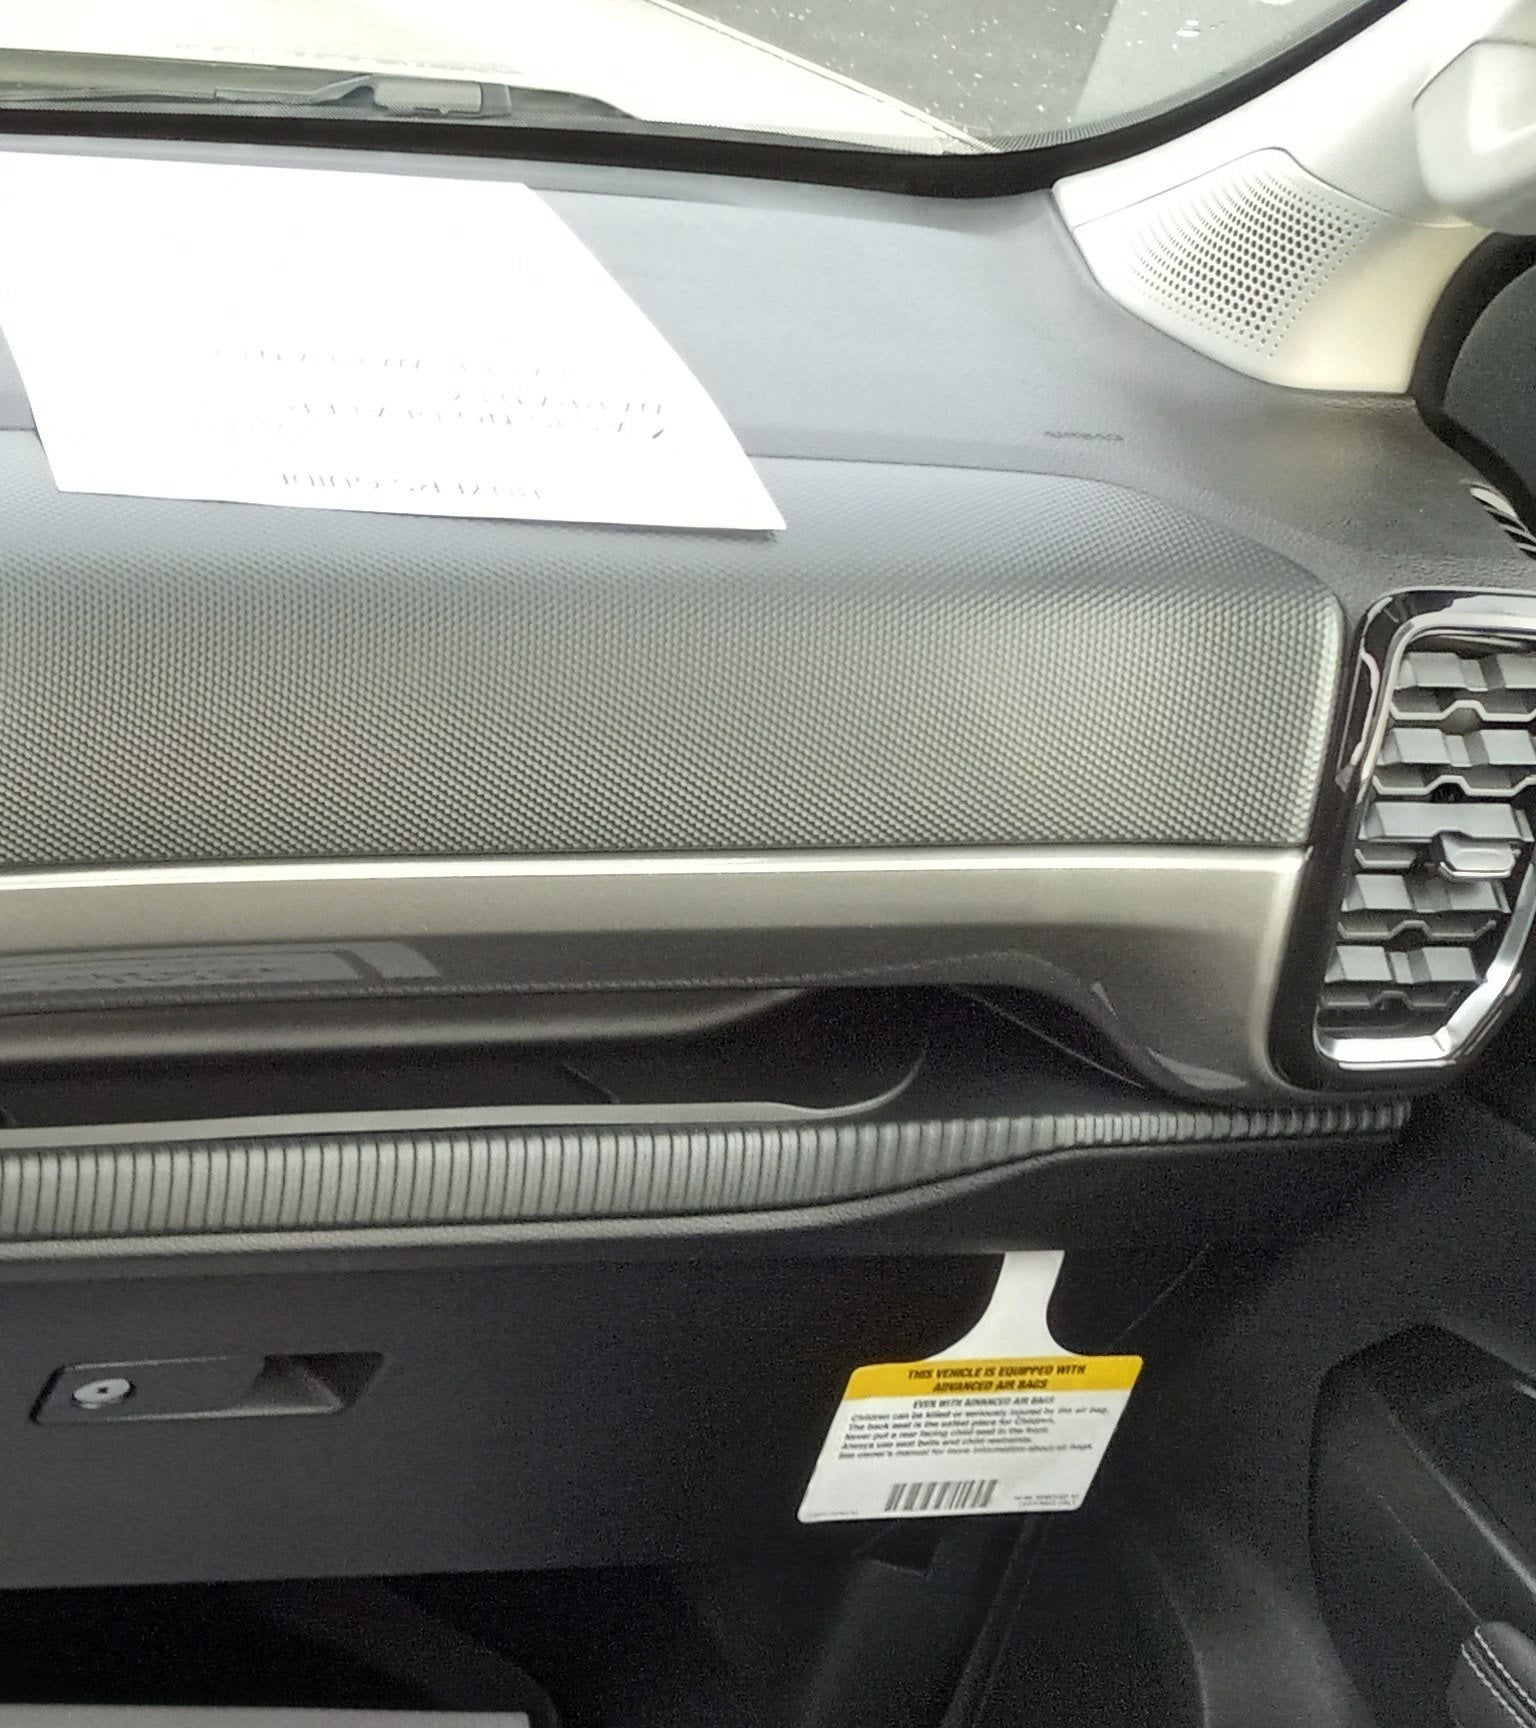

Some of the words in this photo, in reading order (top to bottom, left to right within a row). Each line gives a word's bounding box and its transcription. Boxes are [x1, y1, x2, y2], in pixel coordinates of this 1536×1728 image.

[908, 1369, 932, 1380] THIS
[936, 1367, 983, 1379] VEHICLE
[984, 1366, 995, 1377] IS
[998, 1365, 1054, 1377] EQUIPPED
[1056, 1364, 1086, 1375] WITH
[933, 1381, 994, 1393] ADVANCED
[995, 1380, 1016, 1391] AIR
[1017, 1378, 1049, 1390] BAGS
